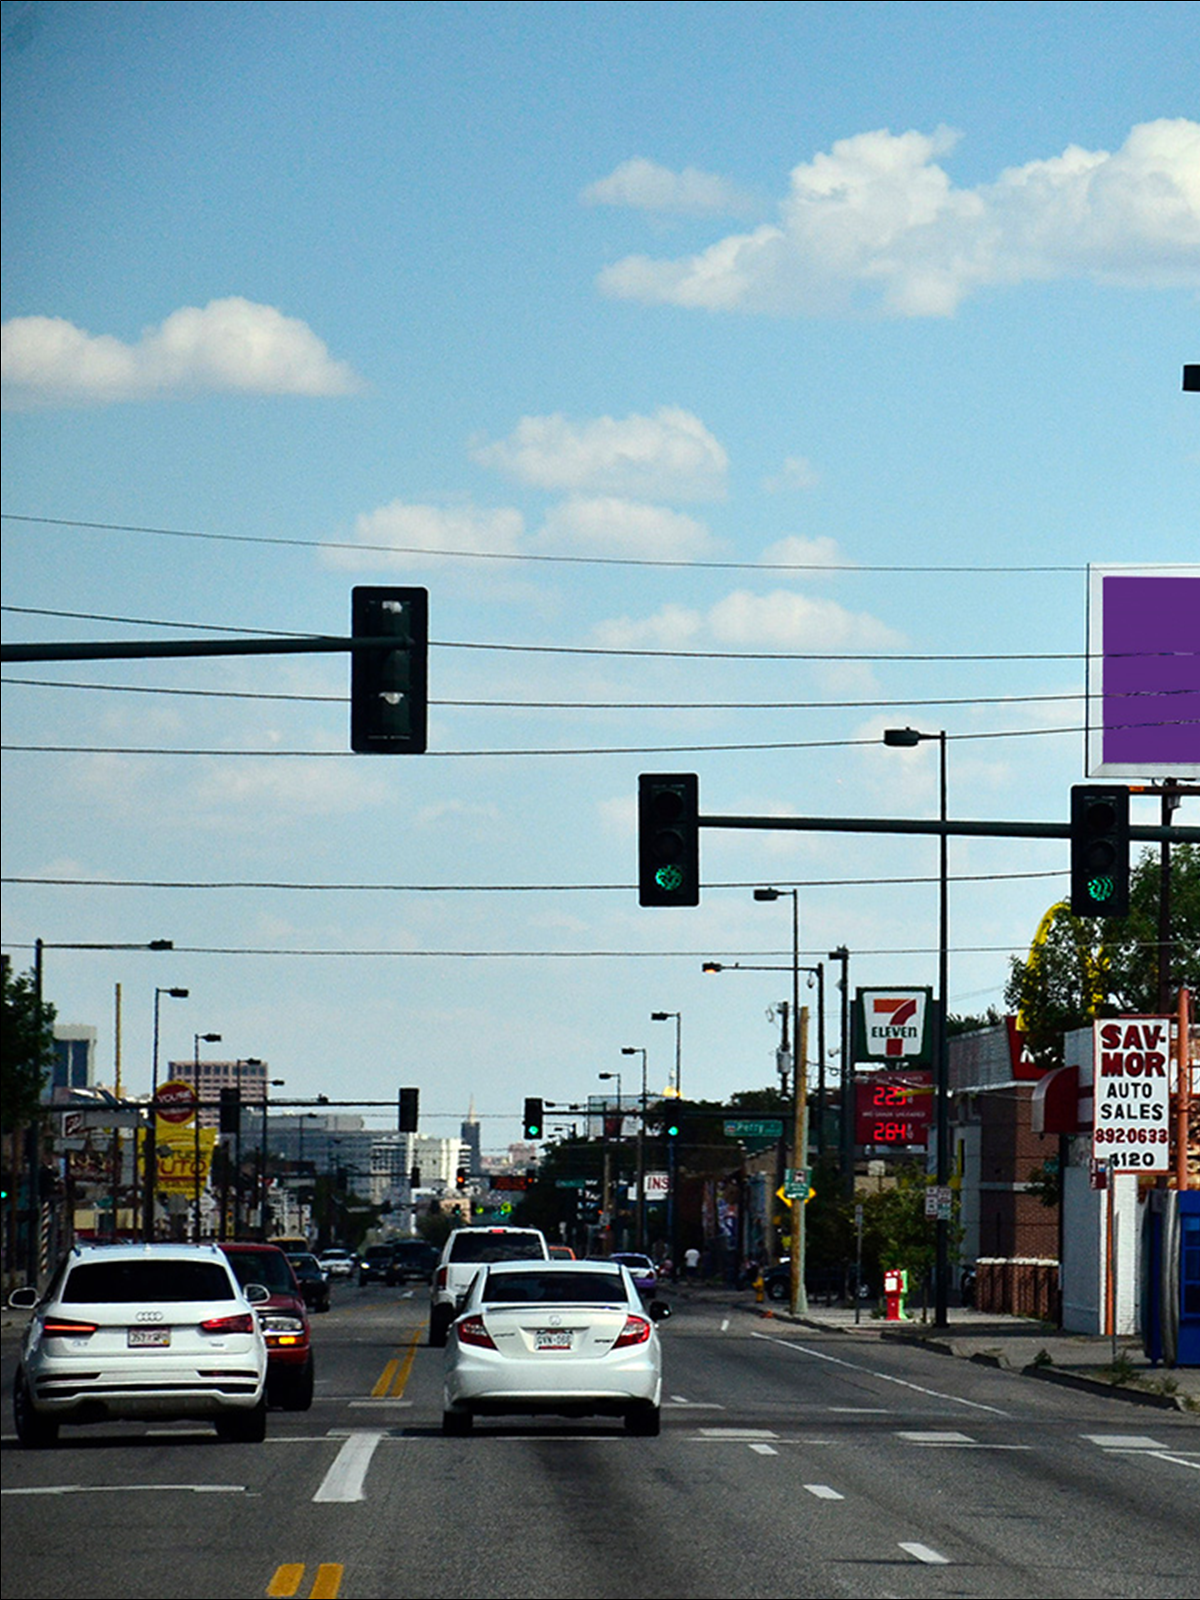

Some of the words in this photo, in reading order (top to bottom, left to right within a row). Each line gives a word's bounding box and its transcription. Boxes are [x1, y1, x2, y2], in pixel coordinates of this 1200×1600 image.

[1100, 1051, 1167, 1078] MOR
[1106, 1082, 1153, 1099] AUTO
[1100, 1103, 1165, 1121] SALES
[156, 1159, 207, 1176] UTO
[1110, 1152, 1156, 1168] 4120
